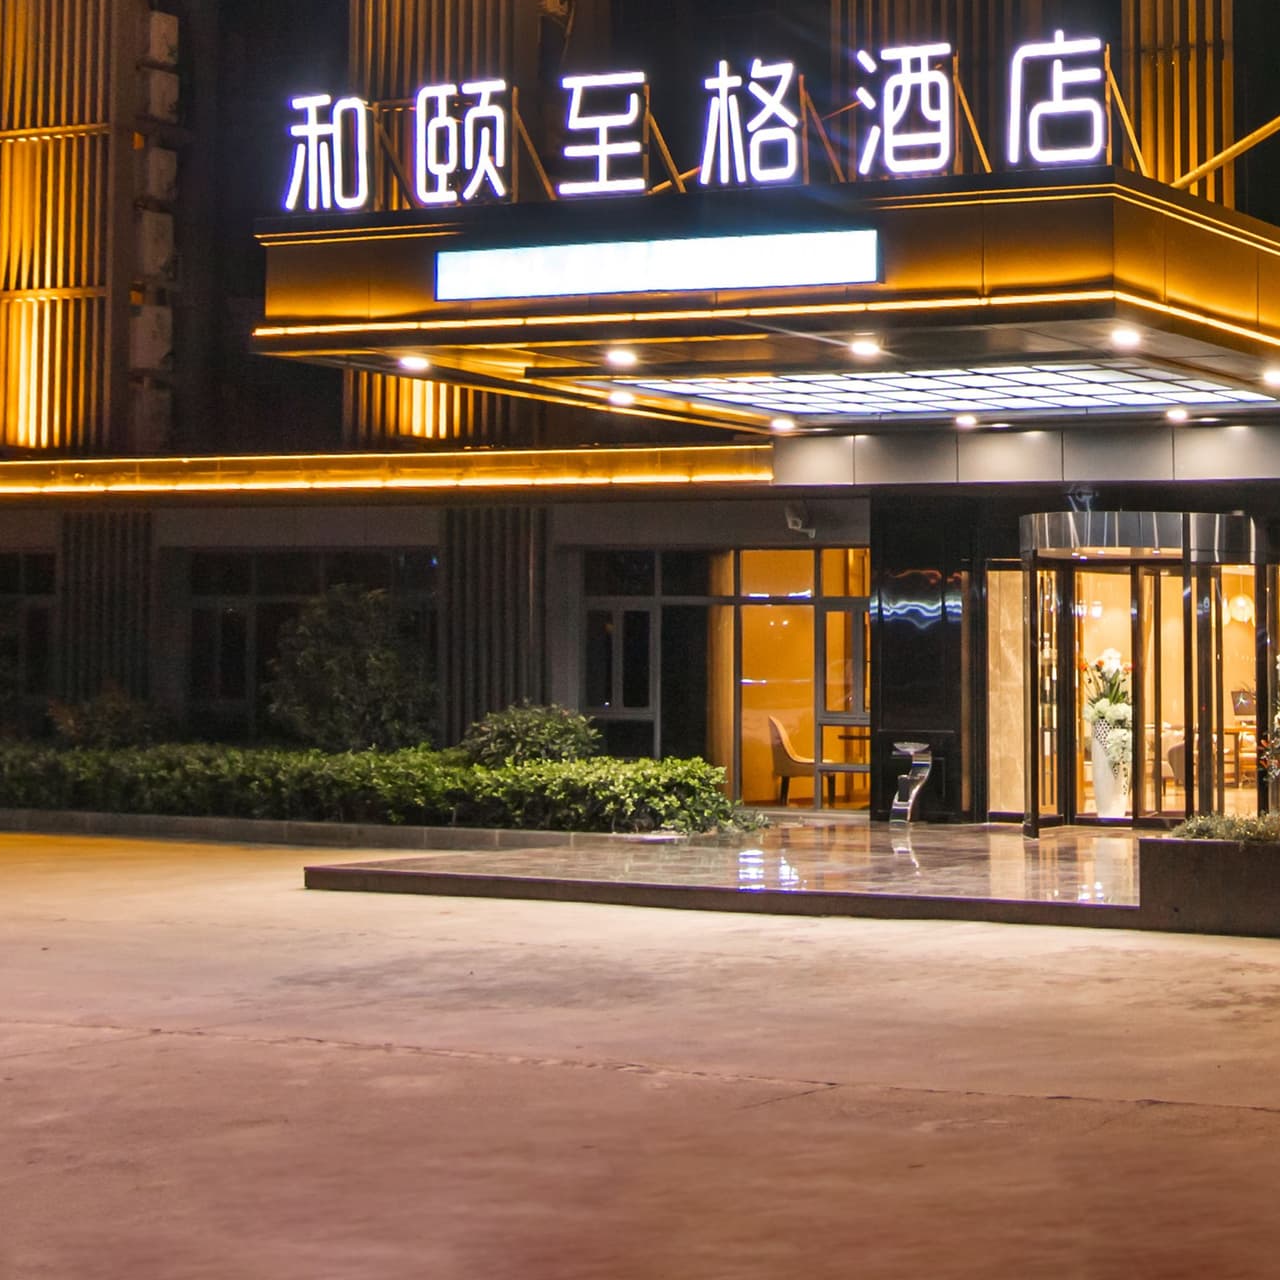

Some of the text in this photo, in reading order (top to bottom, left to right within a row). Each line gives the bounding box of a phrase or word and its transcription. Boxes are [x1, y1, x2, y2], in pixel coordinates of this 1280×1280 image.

[284, 29, 1106, 211] 和颐至格酒店
